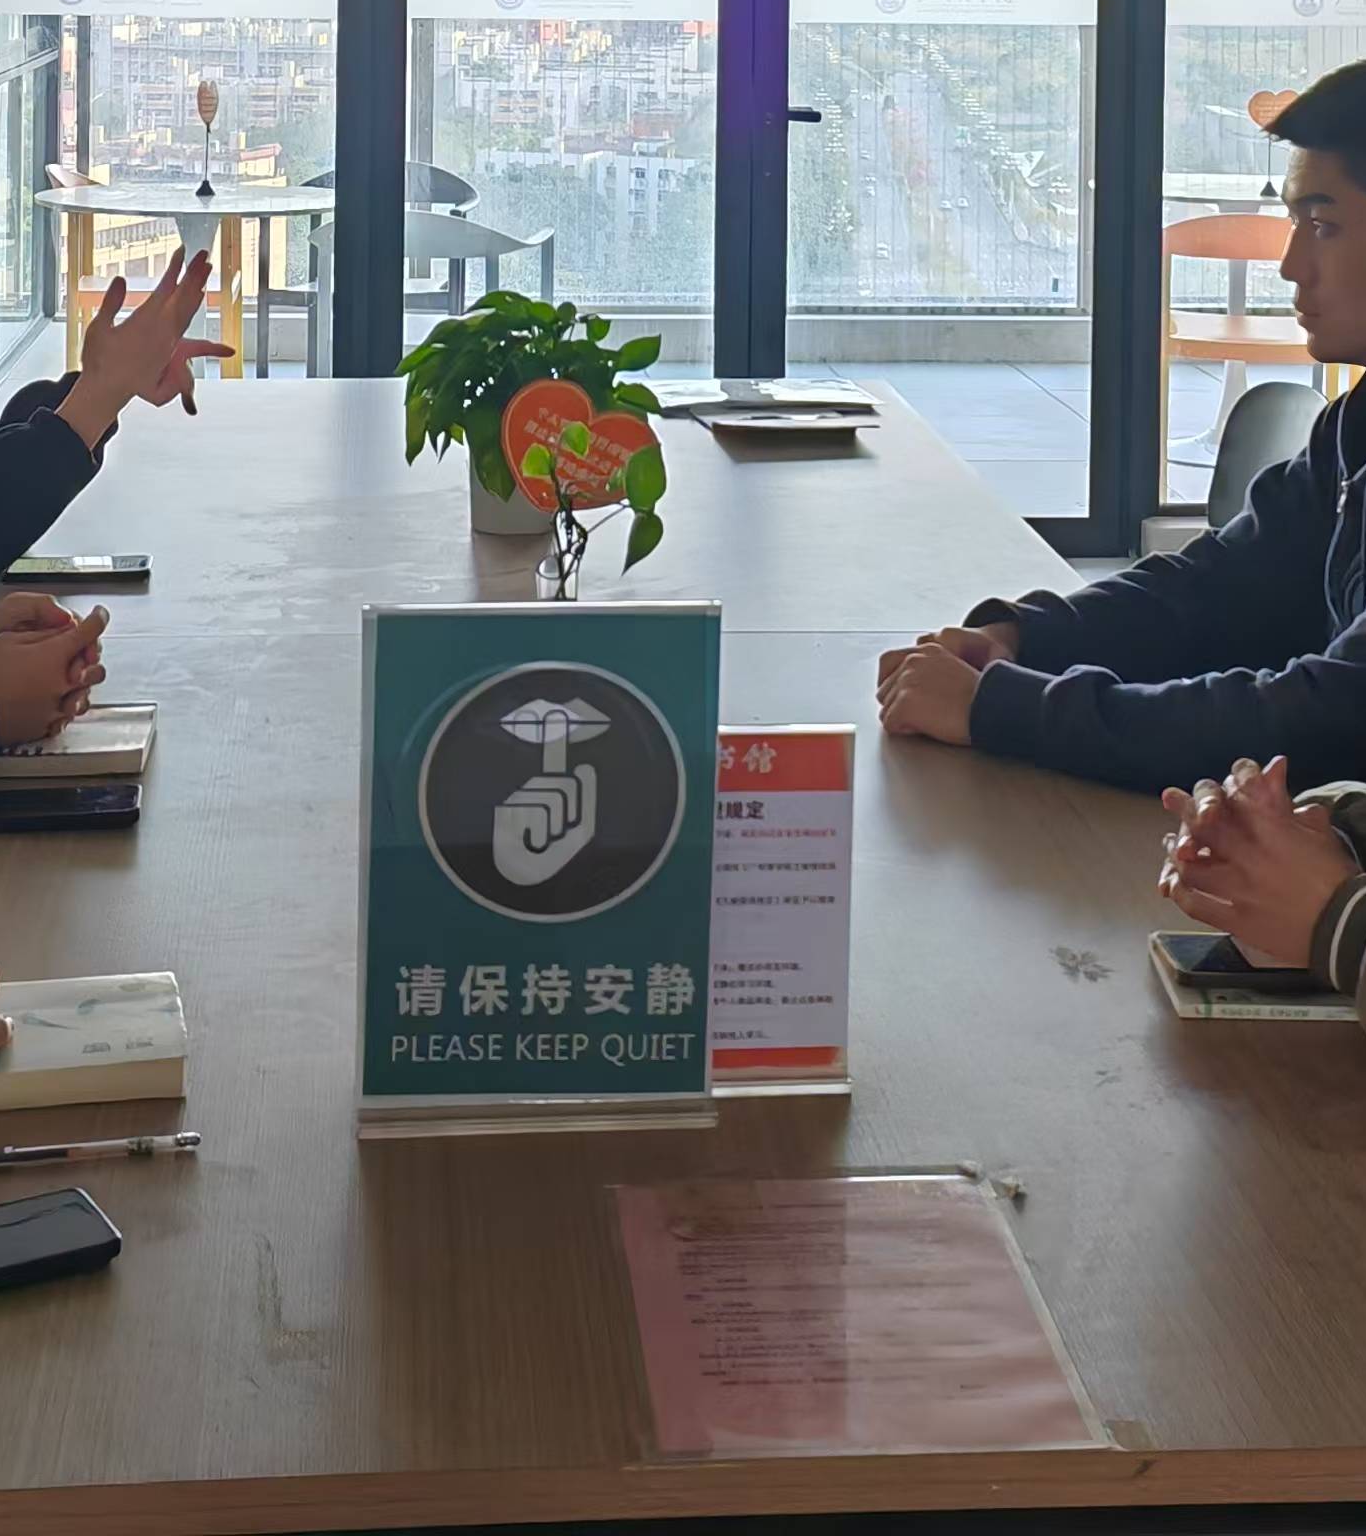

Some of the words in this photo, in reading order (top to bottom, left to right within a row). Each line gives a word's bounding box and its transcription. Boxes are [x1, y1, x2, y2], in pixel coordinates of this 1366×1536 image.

[395, 963, 696, 1016] 请保持安静
[391, 1033, 503, 1062] PLEASE
[515, 1033, 589, 1061] KEEP
[600, 1033, 696, 1067] QUIET
